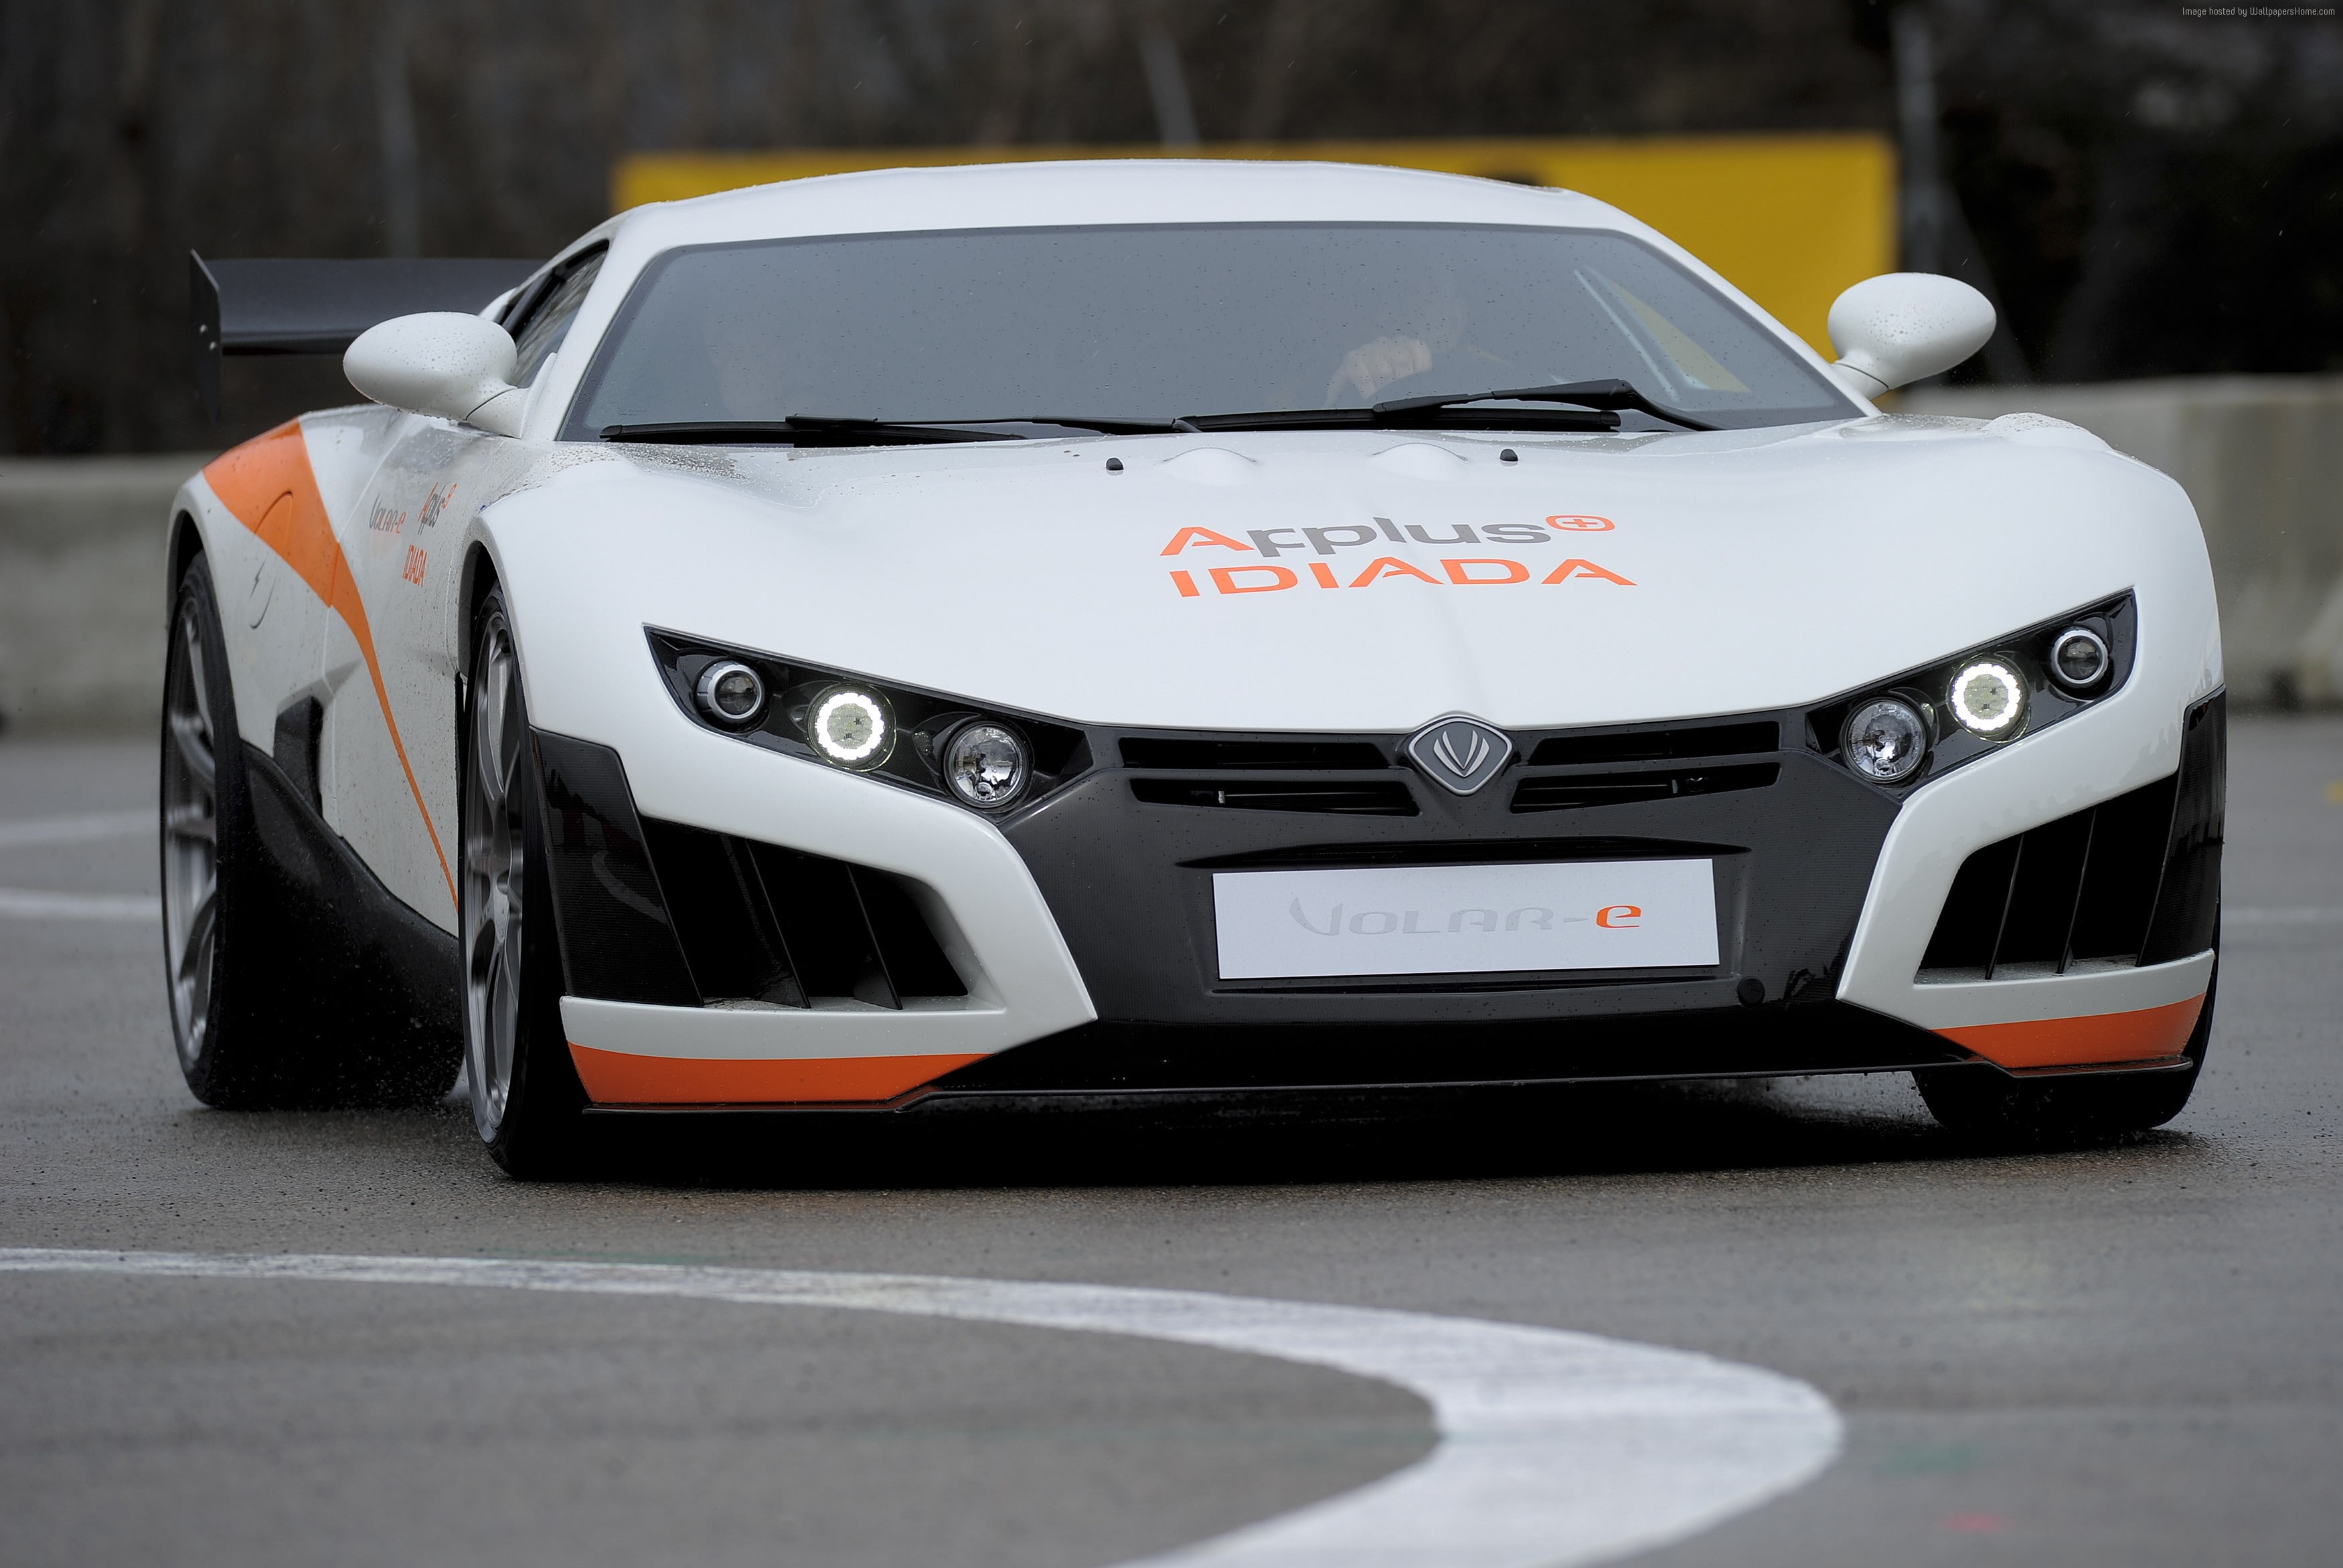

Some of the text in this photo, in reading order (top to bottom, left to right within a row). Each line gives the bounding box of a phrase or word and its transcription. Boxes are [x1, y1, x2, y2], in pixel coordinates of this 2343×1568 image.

[403, 543, 428, 588] IDIADA
[1169, 556, 1639, 598] IDIADA
[1289, 897, 1642, 936] VOLAR-e
